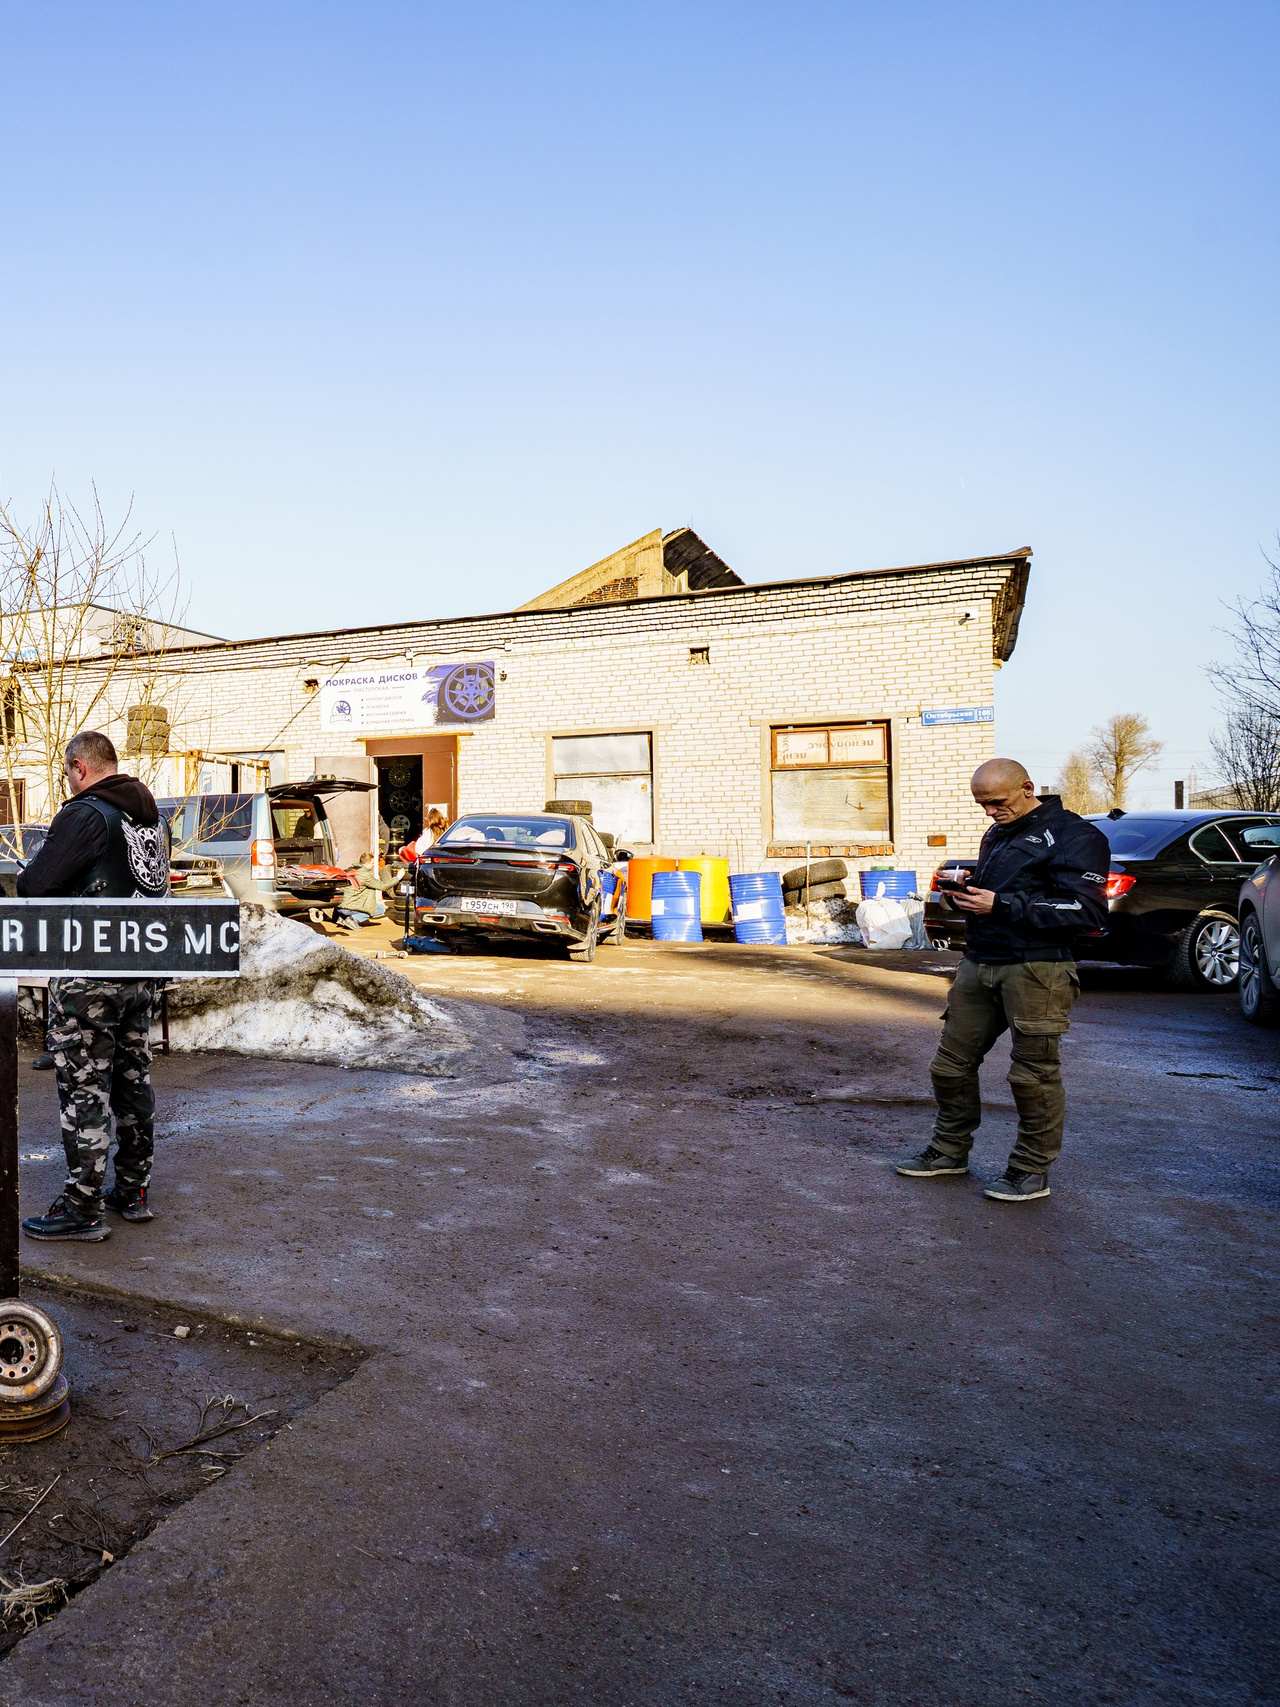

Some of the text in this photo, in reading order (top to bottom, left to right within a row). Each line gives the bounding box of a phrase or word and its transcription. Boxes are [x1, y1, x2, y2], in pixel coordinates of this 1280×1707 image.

[326, 673, 418, 687] ПОКРАСКА ДИСКОВ
[925, 710, 973, 719] Октябрьская
[2, 918, 169, 953] RIDERS
[184, 920, 240, 955] MC
